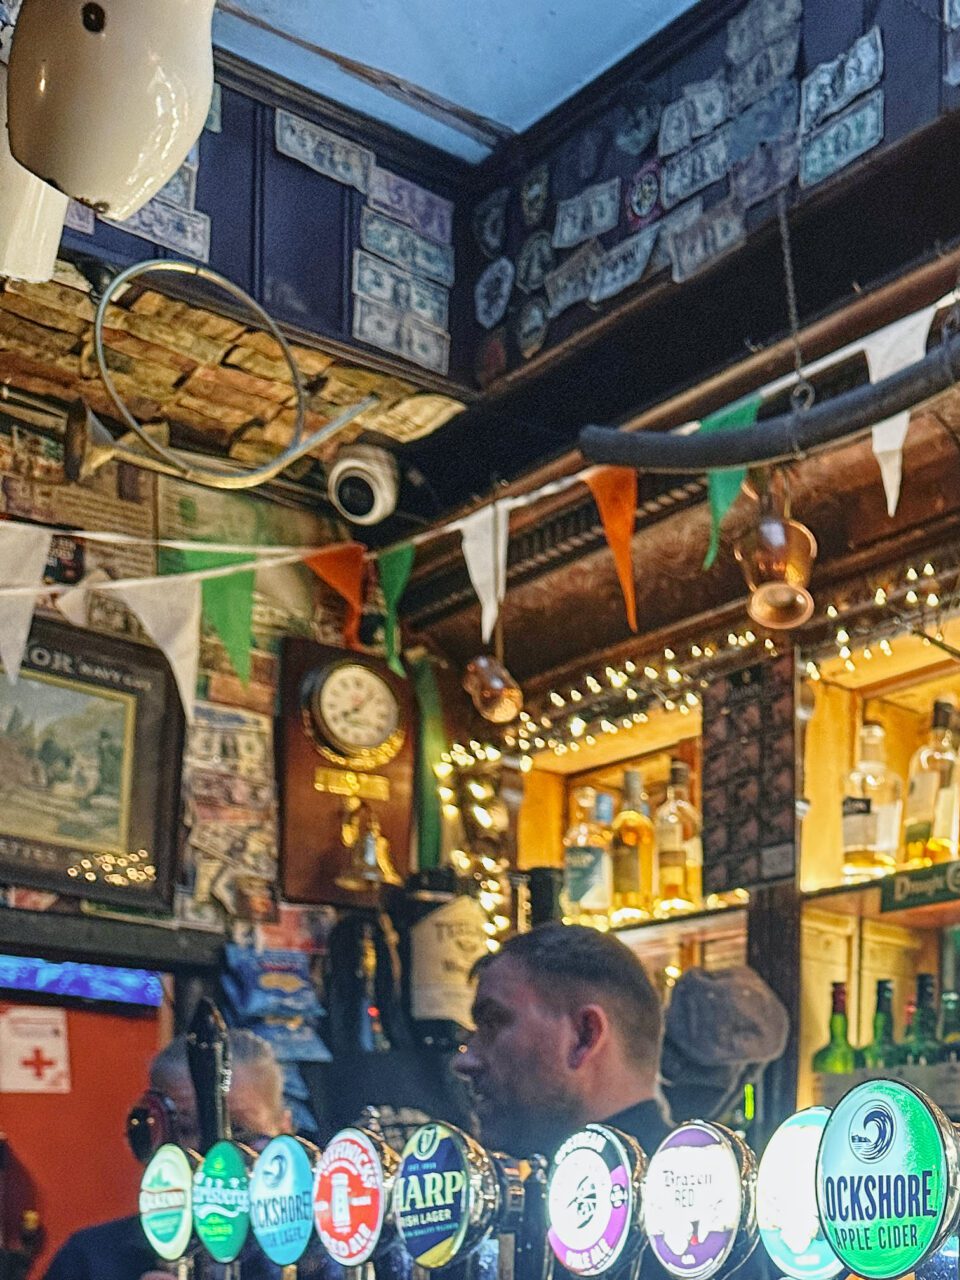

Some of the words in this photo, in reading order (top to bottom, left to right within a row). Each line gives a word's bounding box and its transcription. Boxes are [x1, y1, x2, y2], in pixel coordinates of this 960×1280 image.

[825, 1170, 937, 1222] OCKSHORE
[420, 1209, 452, 1224] LAGER
[834, 1227, 873, 1251] APPLE
[878, 1224, 918, 1249] CIDER
